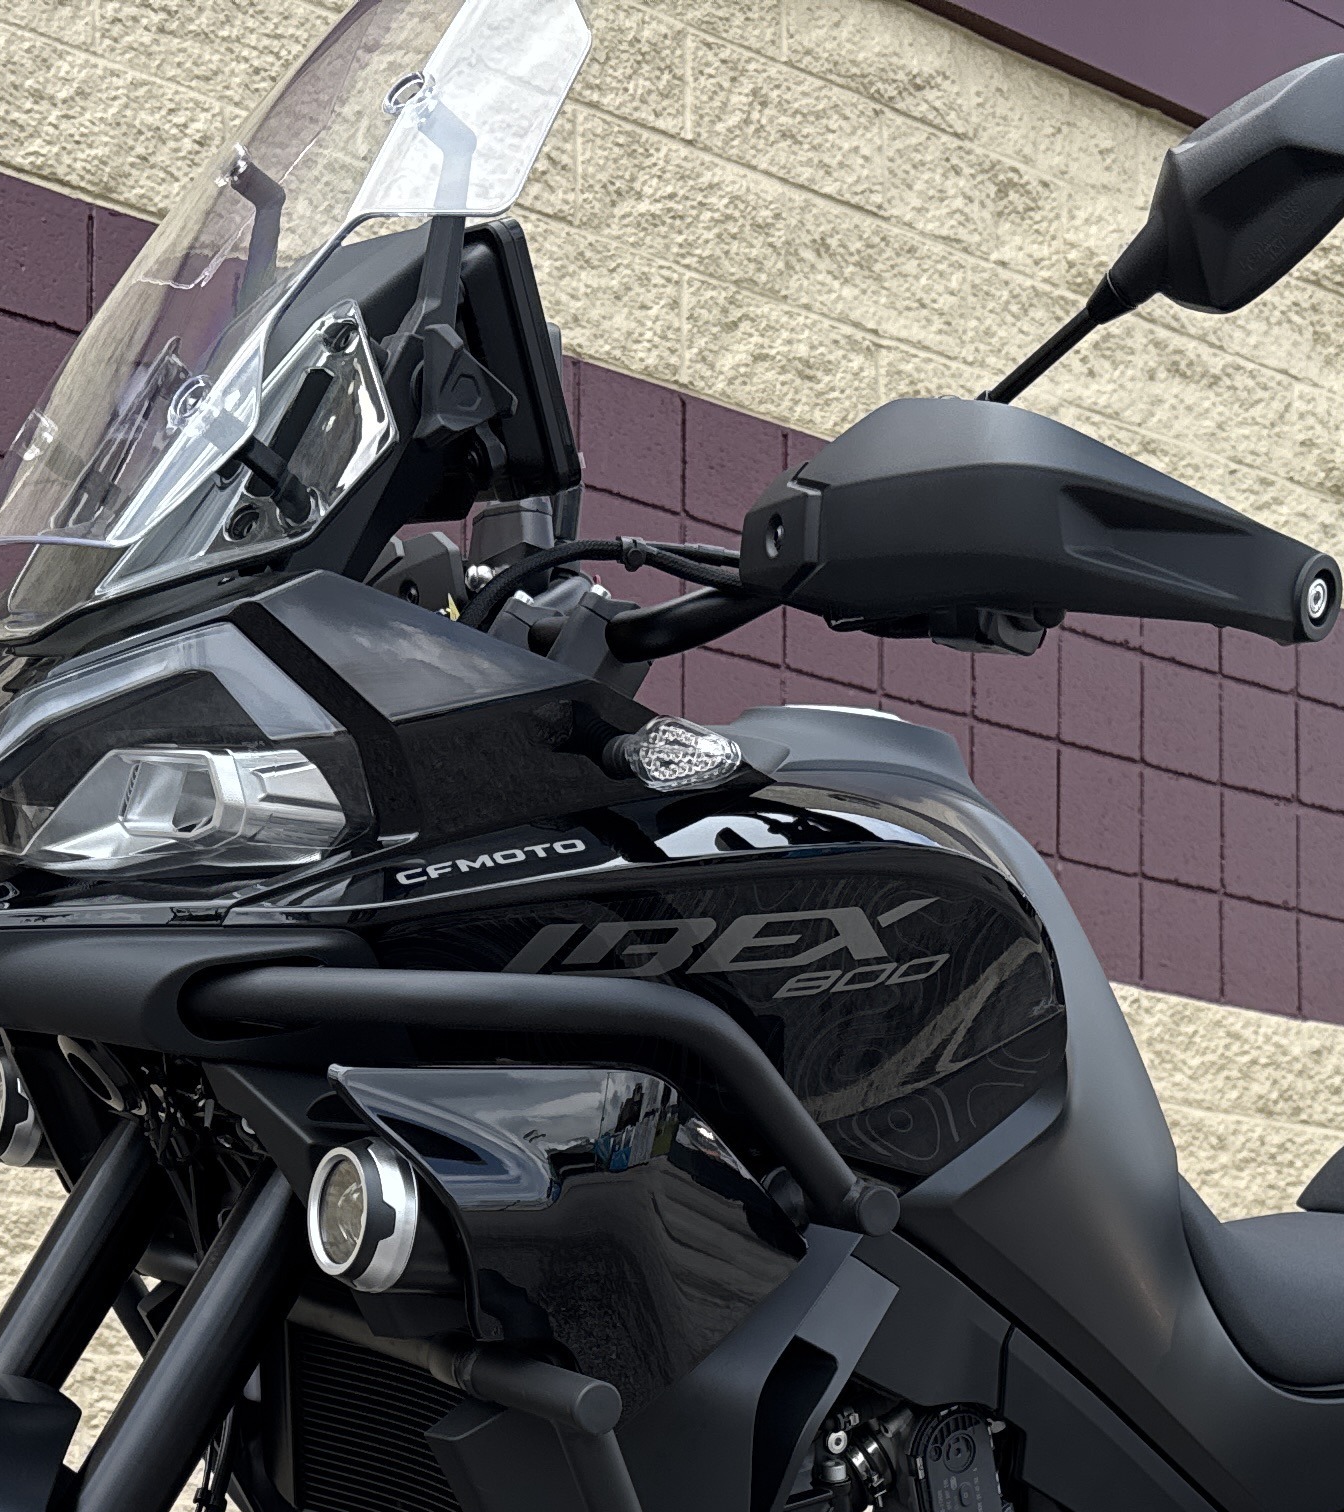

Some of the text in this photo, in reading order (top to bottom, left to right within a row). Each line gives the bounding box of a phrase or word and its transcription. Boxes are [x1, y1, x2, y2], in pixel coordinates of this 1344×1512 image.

[396, 838, 586, 886] CFMOTO
[501, 897, 941, 977] IBEX
[773, 954, 951, 999] 800
